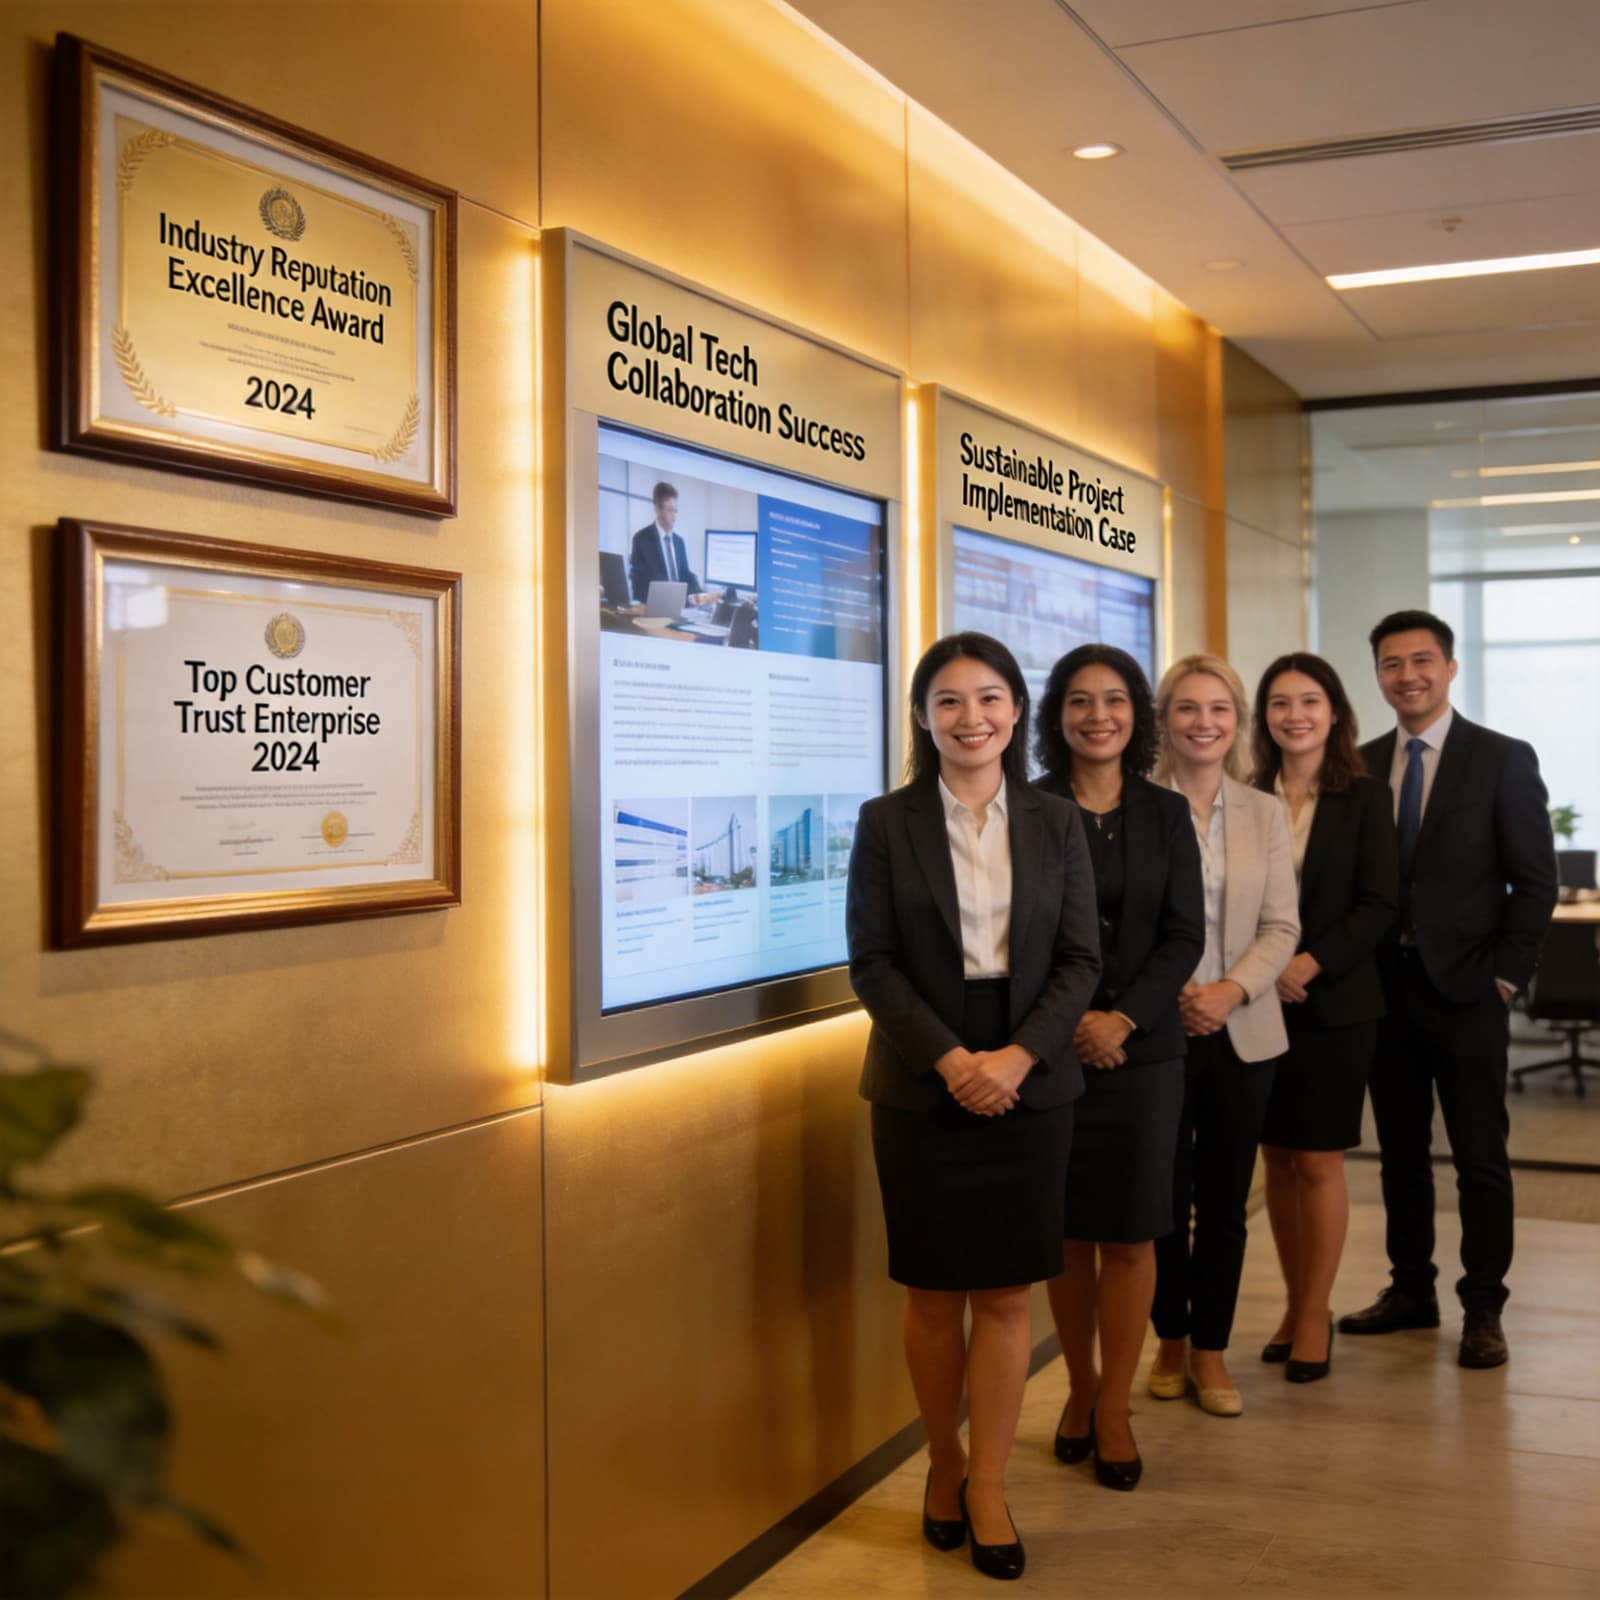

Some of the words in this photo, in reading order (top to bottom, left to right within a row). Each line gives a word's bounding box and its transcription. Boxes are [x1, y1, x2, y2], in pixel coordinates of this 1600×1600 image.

[159, 212, 264, 277] Industry
[271, 247, 392, 307] Reputation
[168, 256, 304, 322] Excellence
[311, 297, 385, 344] Award
[607, 301, 693, 364] Global
[700, 331, 758, 386] Tech
[245, 376, 315, 419] 2024
[607, 351, 771, 434] Collaboration
[778, 403, 865, 461] Success
[960, 432, 1063, 495] Sustainable
[1069, 469, 1124, 514] Project
[962, 473, 1094, 542] Implementation
[1100, 517, 1136, 553] Case
[184, 660, 237, 701] Top
[246, 664, 371, 698] Customer
[174, 701, 246, 733] Trust
[254, 703, 381, 743] Enterprise
[251, 741, 320, 772] 2024
